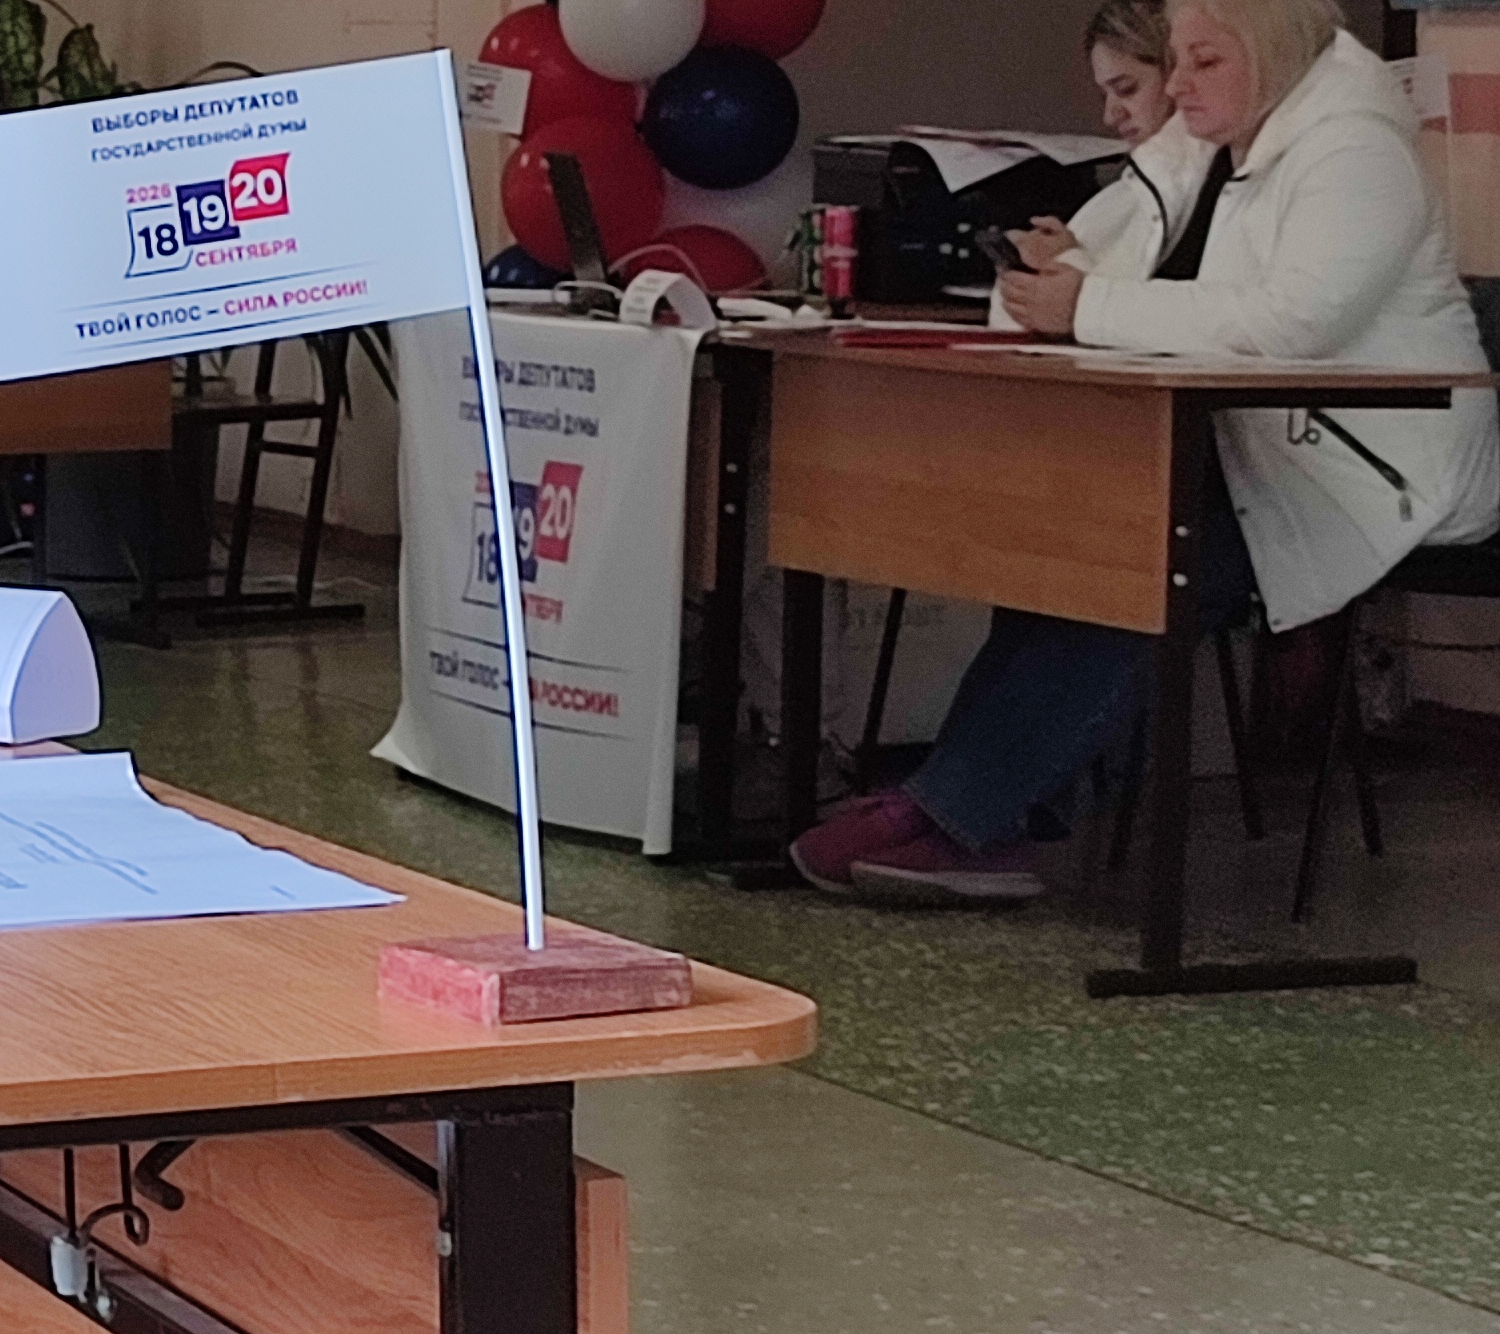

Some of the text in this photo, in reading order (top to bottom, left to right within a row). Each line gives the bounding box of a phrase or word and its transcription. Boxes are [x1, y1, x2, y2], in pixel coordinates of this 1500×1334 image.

[91, 89, 300, 134] ВЫБОРЫ ДЕПУТАТОВ
[91, 119, 307, 162] ГОСУДАРСТВЕННОЙ ДУМЫ
[126, 183, 172, 204] 2026
[230, 168, 283, 210] 20
[182, 194, 227, 235] 19
[137, 223, 180, 259] 18
[195, 238, 298, 268] СЕНТЯБРЯ
[75, 313, 131, 340] ТВОЙ
[135, 305, 202, 330] ГОЛОС
[224, 293, 279, 317] СИЛА
[282, 279, 369, 307] РОССИИ!
[517, 361, 595, 394] ДЕПУТАТОВ
[539, 482, 573, 540] 20
